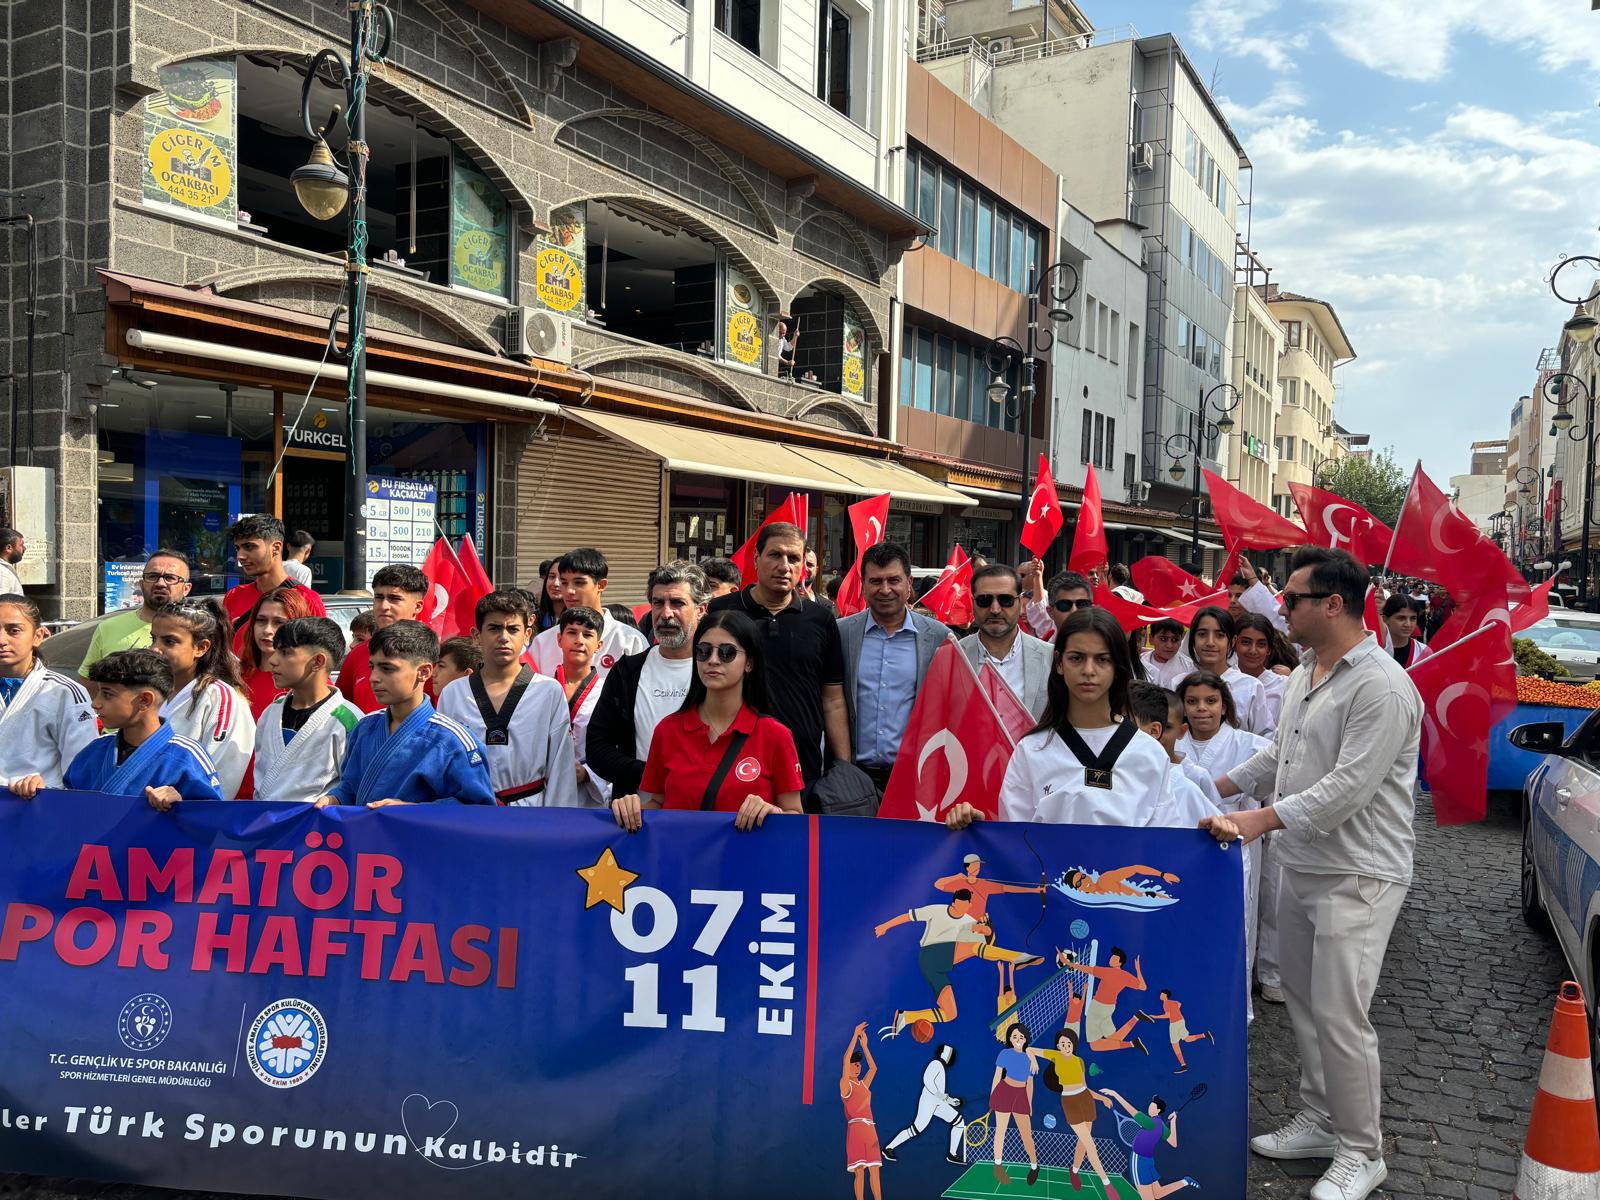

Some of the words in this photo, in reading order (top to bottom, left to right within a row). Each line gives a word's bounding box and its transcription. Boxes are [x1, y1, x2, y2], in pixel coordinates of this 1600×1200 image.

[161, 171, 219, 197] OCAKBAŞI
[168, 185, 185, 196] 444
[187, 189, 199, 200] 35
[201, 193, 212, 204] 21
[381, 479, 393, 489] BU
[394, 480, 434, 492] FIRSATLAR
[389, 489, 427, 500] KAÇMAZ!
[370, 505, 376, 516] 5
[393, 506, 410, 515] 500
[416, 508, 431, 517] 190
[369, 526, 377, 537] 8
[393, 526, 409, 536] 500
[415, 528, 431, 536] 210
[368, 547, 381, 558] 15
[65, 830, 404, 914] AMATÖR
[0, 902, 174, 971] POR
[191, 911, 519, 989] HAFTASI
[610, 885, 744, 957] 07
[748, 892, 796, 1036] EKİM
[280, 999, 313, 1013] KULÜPLERİ
[623, 962, 726, 1033] 11
[264, 1003, 280, 1017] SPOR
[249, 1015, 265, 1044] AMATÖR
[309, 1011, 326, 1073] KONFEDERASYONU
[49, 1053, 69, 1065] T.C.
[70, 1054, 118, 1069] GENÇLİK
[120, 1057, 134, 1068] VE
[135, 1058, 166, 1070] SPOR
[167, 1060, 227, 1074] BAKANLIĞI
[248, 1045, 261, 1073] TÜRKİYE
[59, 1070, 82, 1080] SPOR
[82, 1071, 131, 1083] HİZMETLERİ
[131, 1074, 158, 1084] GENEL
[158, 1076, 212, 1088] MÜDÜRLÜĞÜ
[2, 1108, 48, 1131] ler
[63, 1105, 165, 1139] Türk
[184, 1113, 408, 1155] Sporunun
[424, 1136, 579, 1168] Kalbidir
